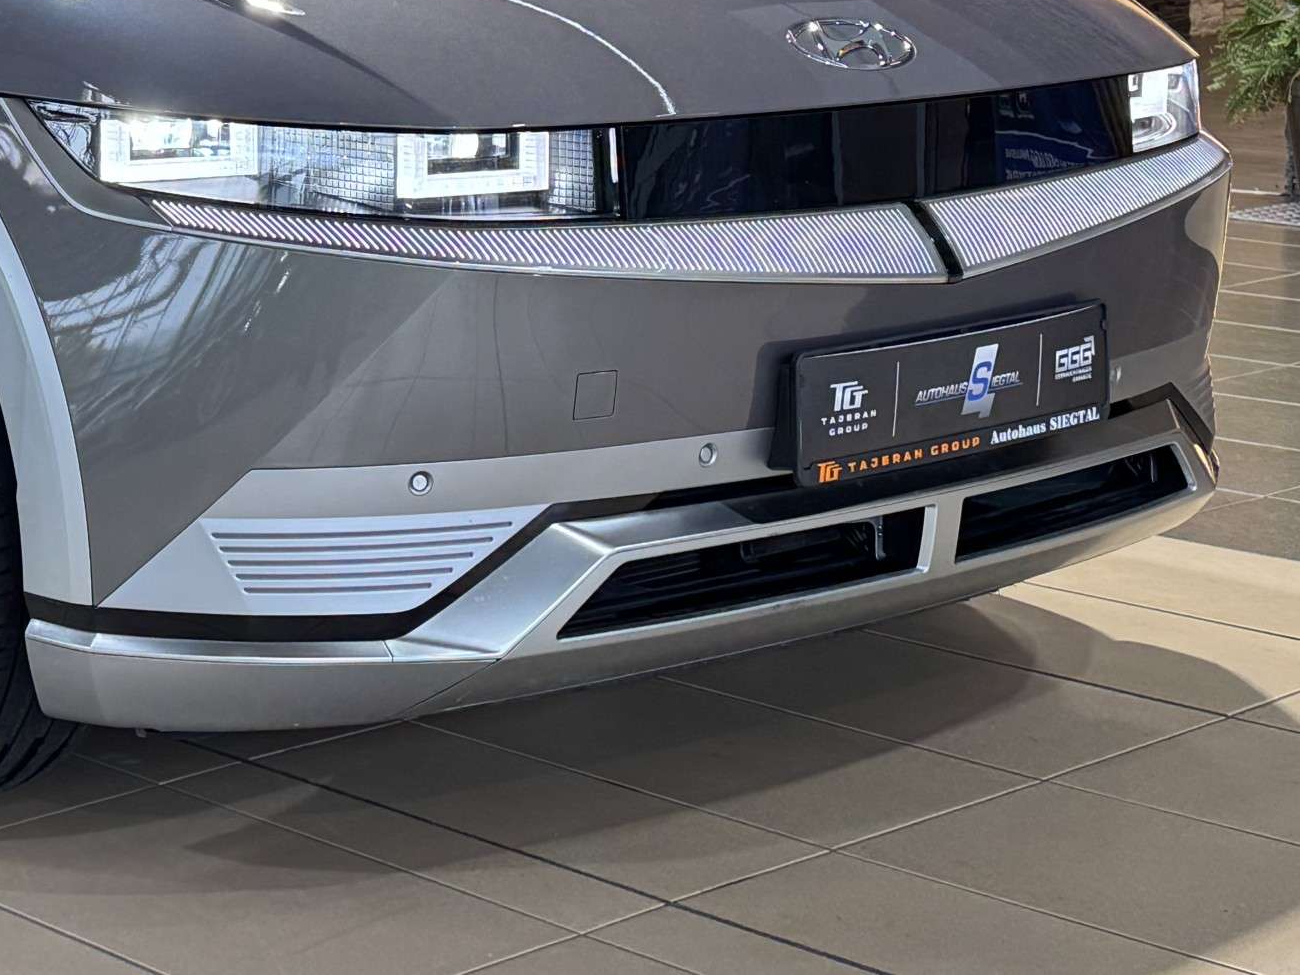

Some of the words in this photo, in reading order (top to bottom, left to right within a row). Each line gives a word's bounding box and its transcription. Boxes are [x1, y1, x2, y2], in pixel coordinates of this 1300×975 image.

[915, 382, 968, 403] AUTOHAUS
[821, 409, 877, 426] TAJERAN
[990, 425, 1046, 445] Autohaus
[1049, 406, 1100, 431] SIEGTAL
[829, 422, 869, 436] GROUP
[848, 449, 924, 473] TAJERAN
[930, 436, 980, 456] GROUP
